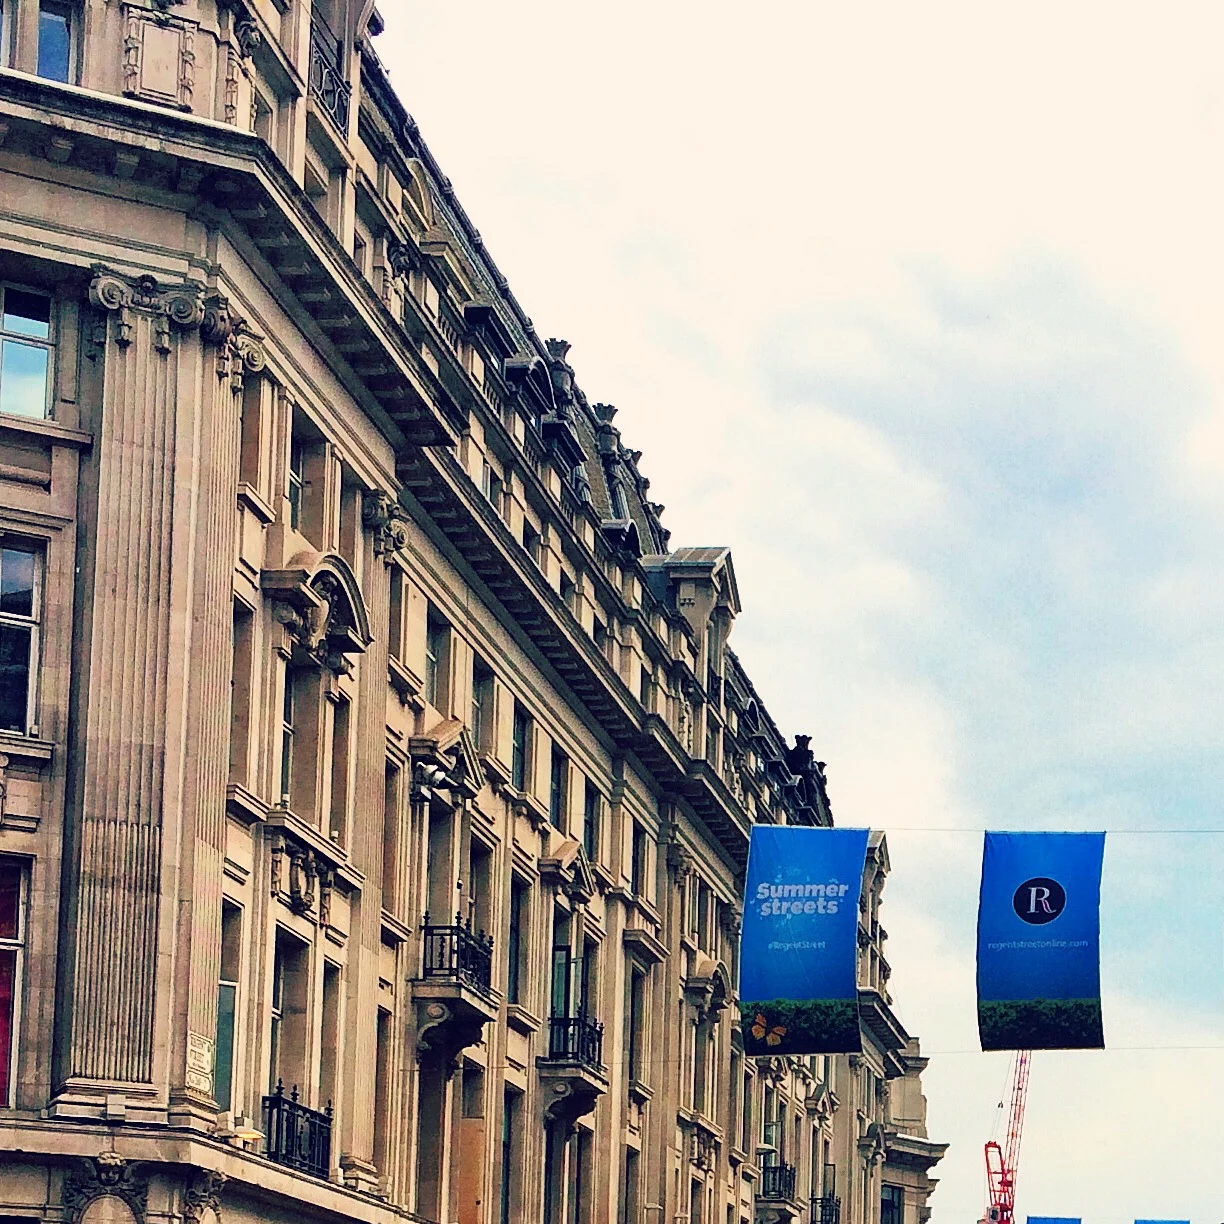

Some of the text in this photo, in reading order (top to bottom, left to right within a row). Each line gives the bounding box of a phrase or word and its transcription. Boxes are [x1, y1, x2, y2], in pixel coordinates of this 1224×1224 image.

[756, 882, 849, 899] Summer
[760, 898, 839, 916] streets
[1026, 886, 1057, 914] R
